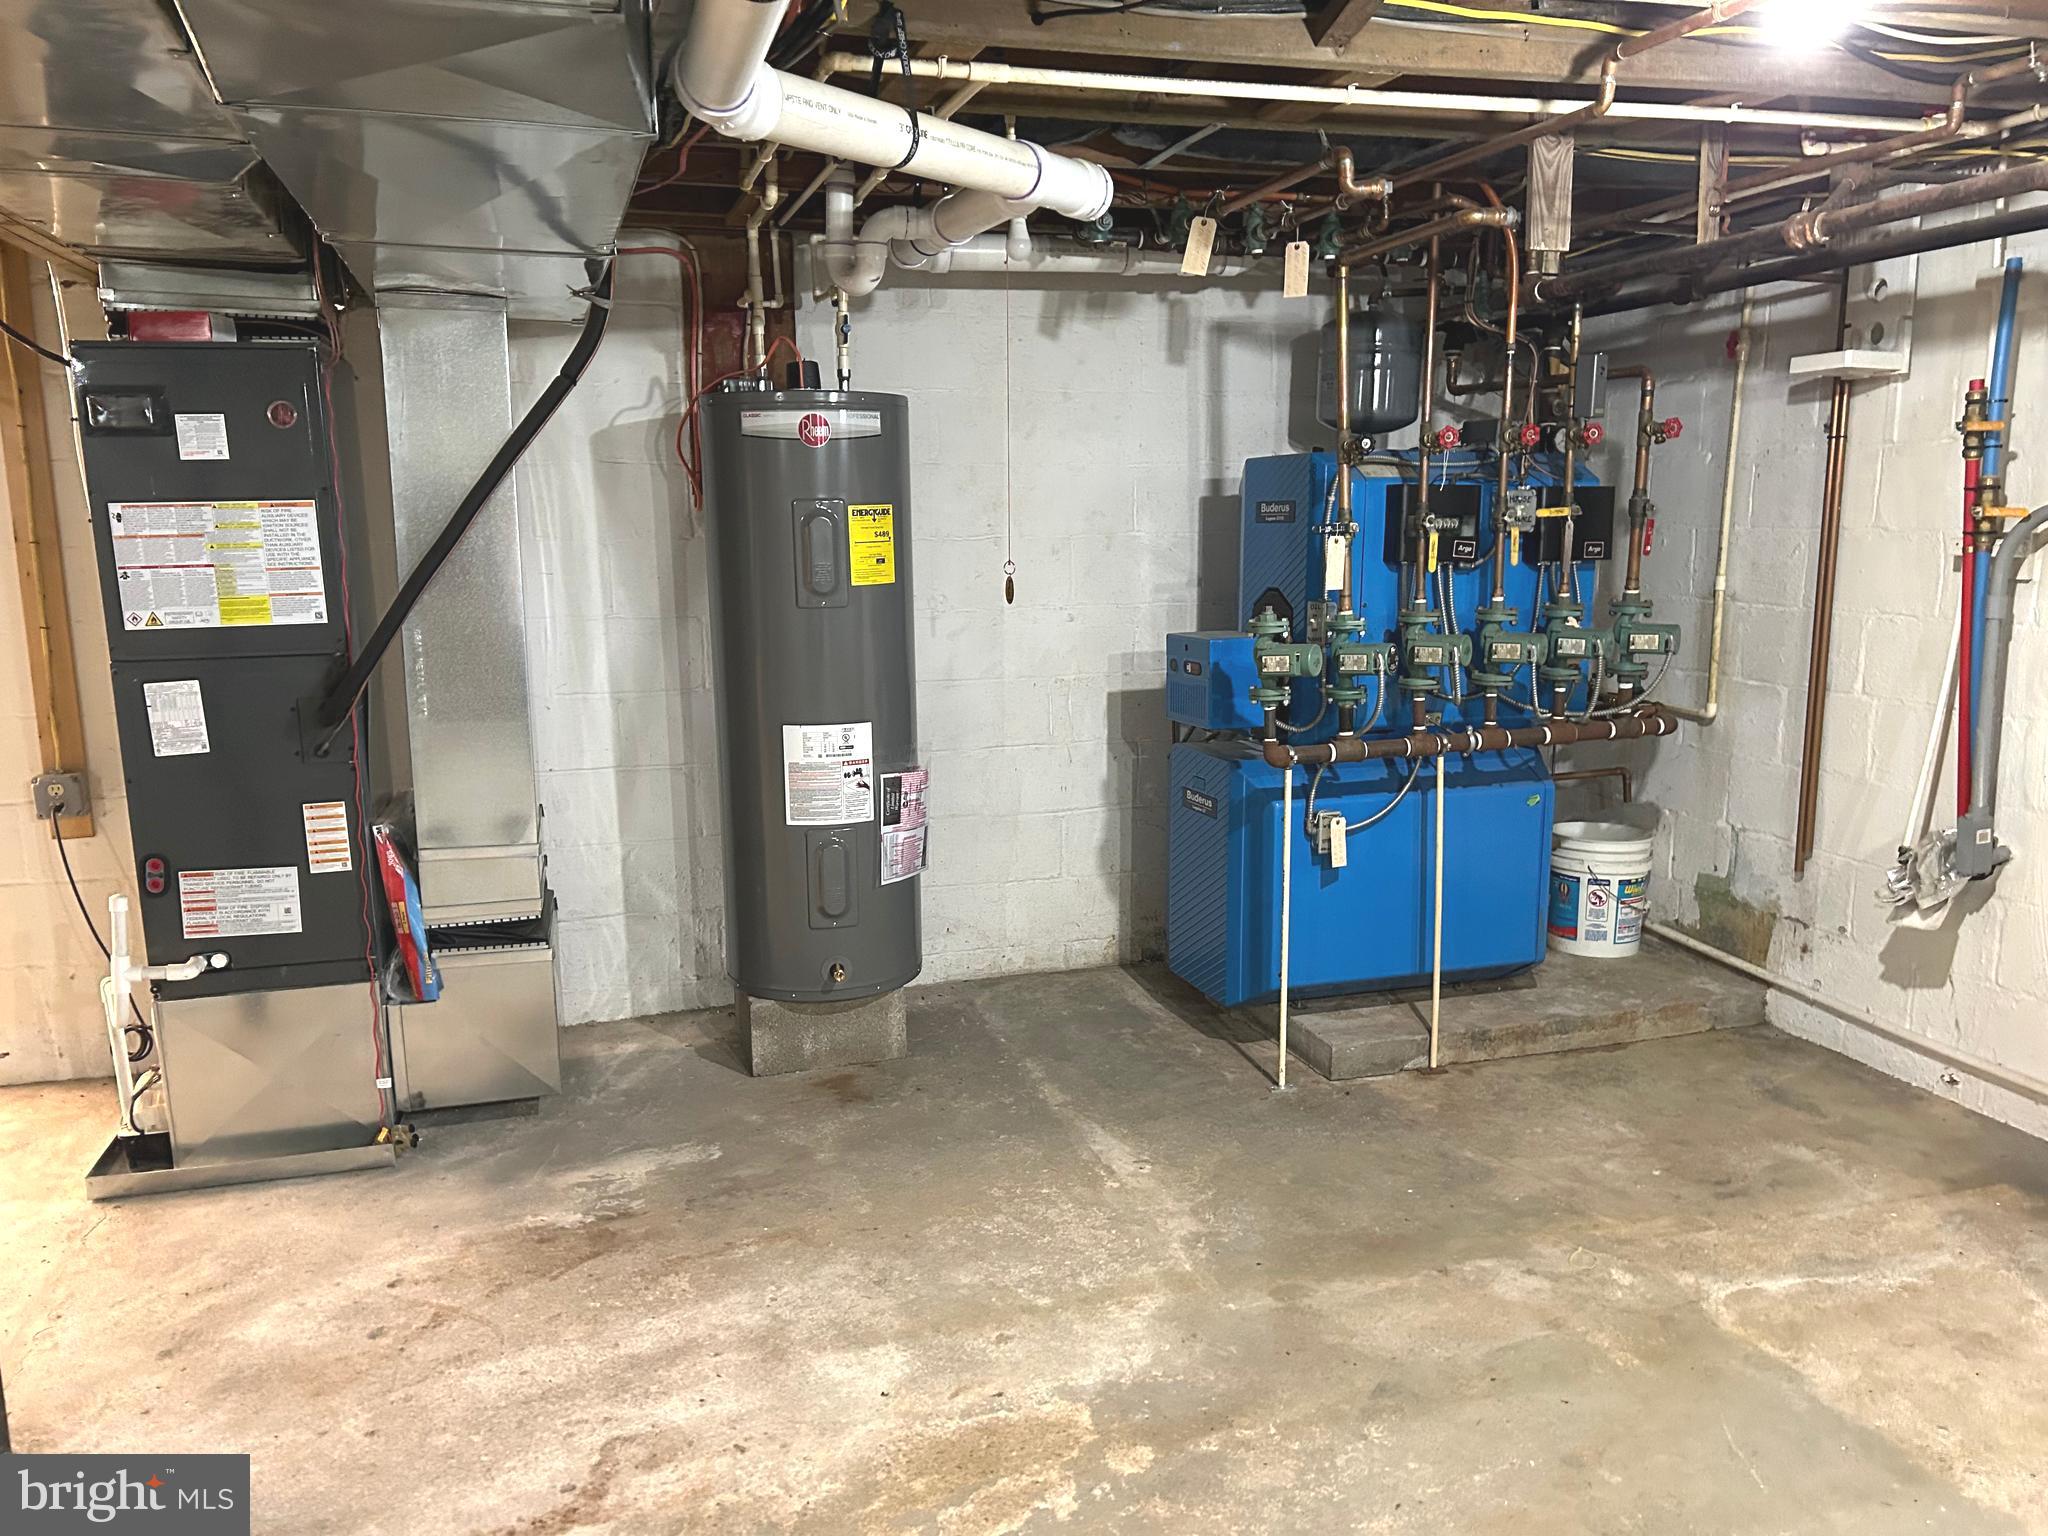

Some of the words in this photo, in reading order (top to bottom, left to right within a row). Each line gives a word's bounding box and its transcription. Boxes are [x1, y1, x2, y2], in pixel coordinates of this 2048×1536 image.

[801, 419, 830, 442] Rheem
[1260, 503, 1290, 512] Buderus
[1458, 545, 1472, 553] Argo
[1186, 790, 1212, 807] Buderus
